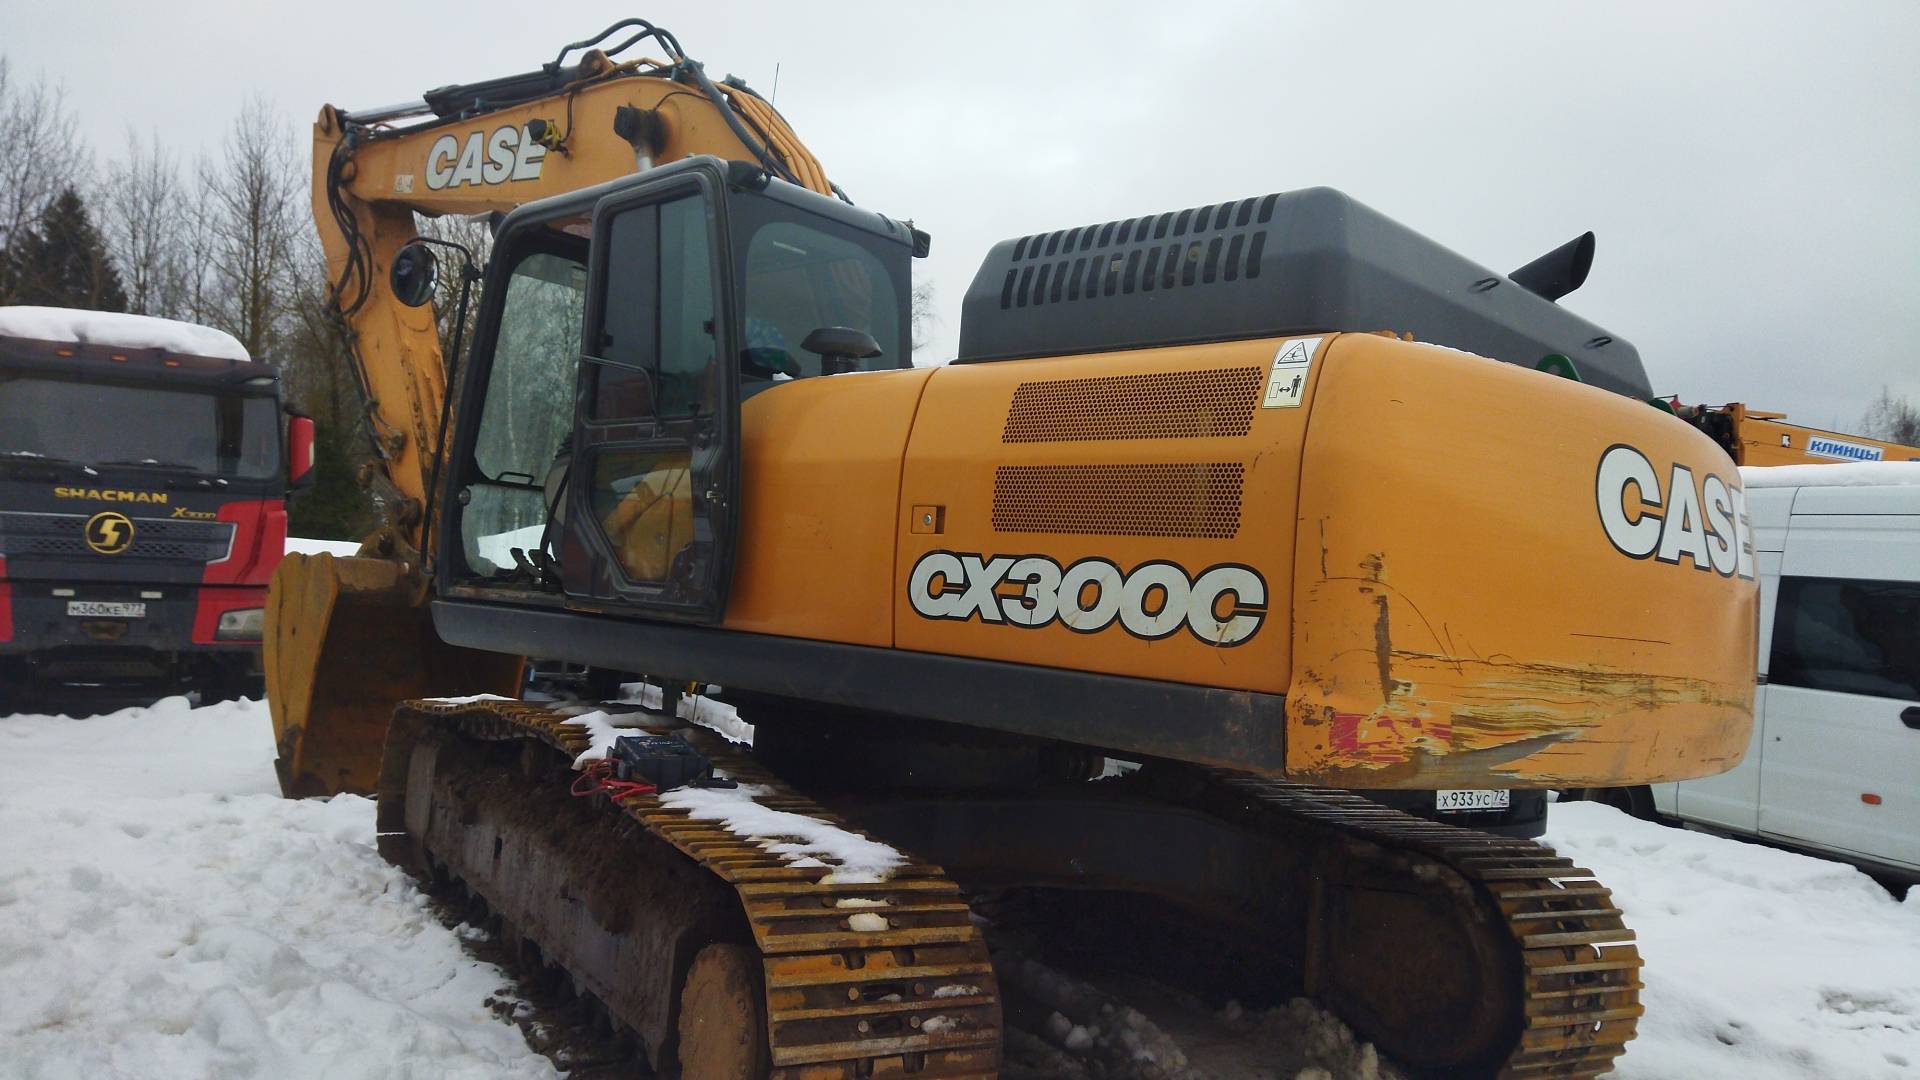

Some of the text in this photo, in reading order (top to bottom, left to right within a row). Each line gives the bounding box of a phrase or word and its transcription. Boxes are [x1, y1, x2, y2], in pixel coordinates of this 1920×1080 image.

[425, 123, 548, 191] CASE
[1810, 440, 1881, 461] КЛИНЦЫ
[54, 487, 168, 503] SHACMAN
[1595, 443, 1755, 581] CASE
[907, 549, 1269, 647] CX300C
